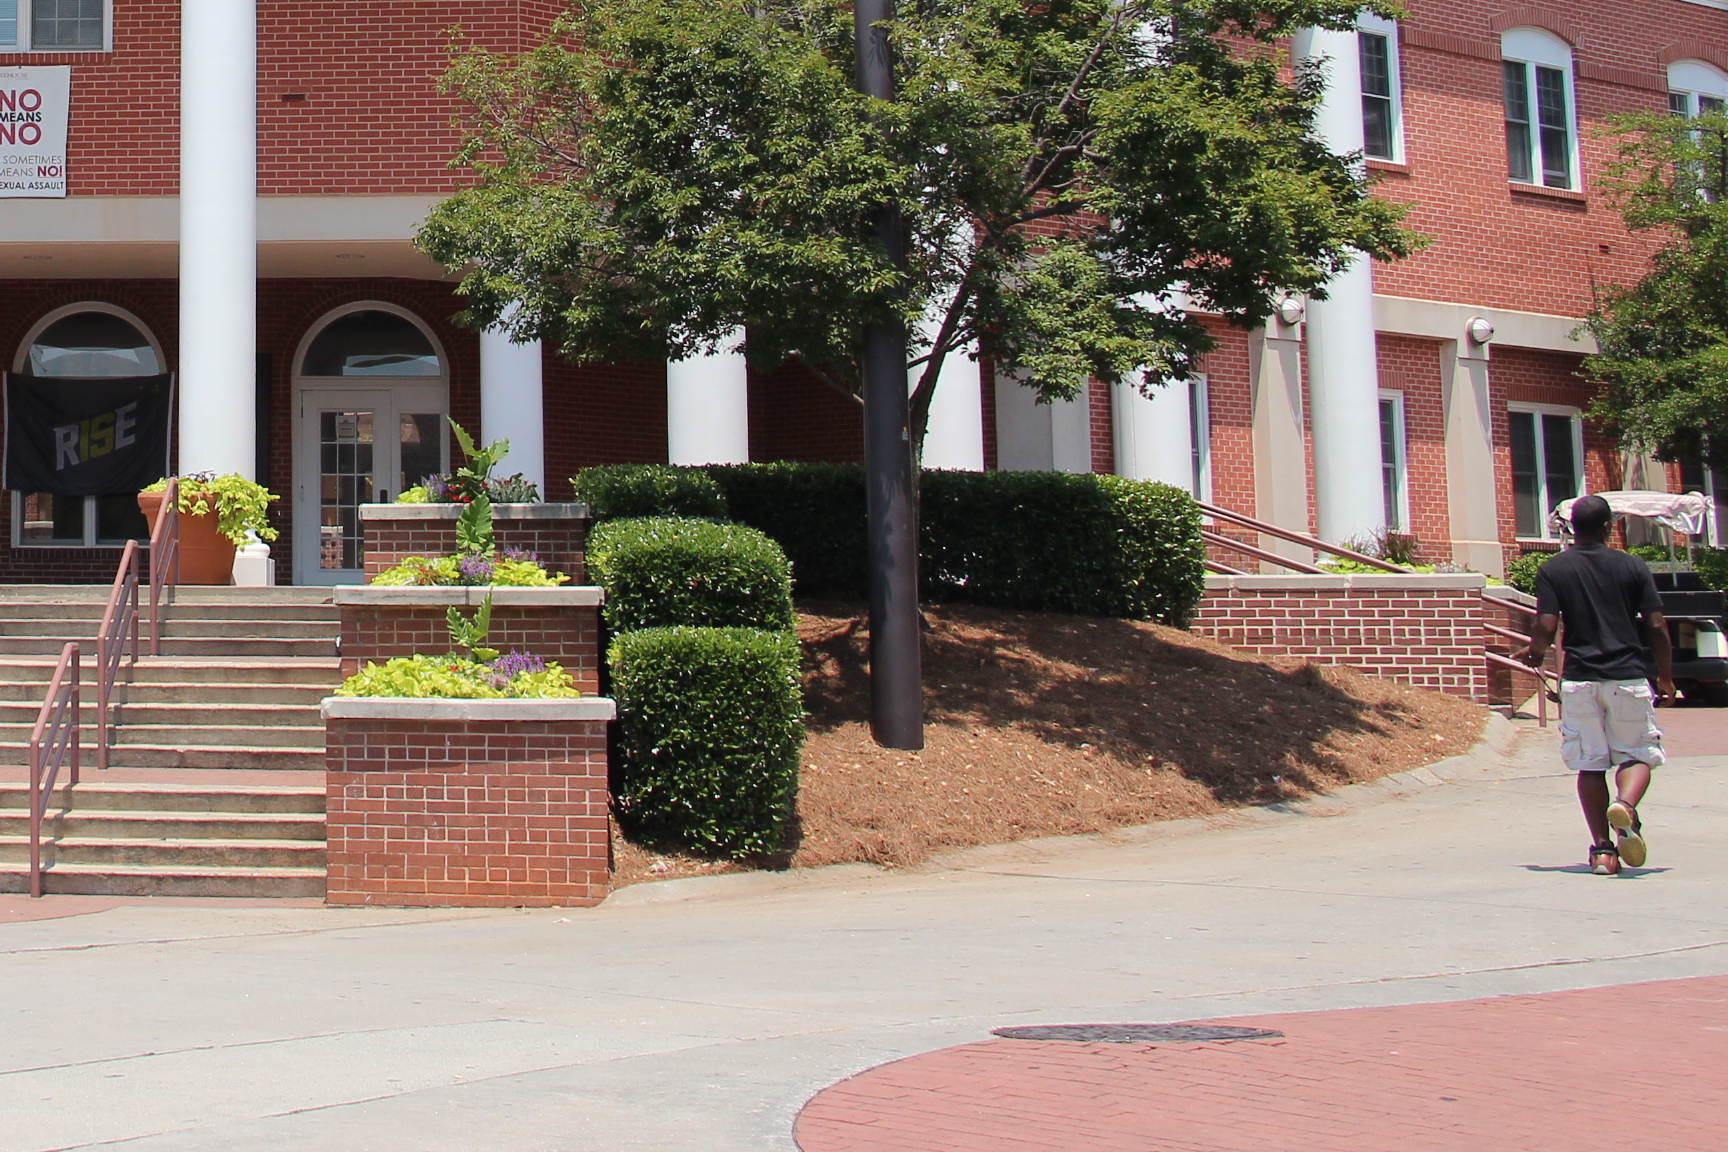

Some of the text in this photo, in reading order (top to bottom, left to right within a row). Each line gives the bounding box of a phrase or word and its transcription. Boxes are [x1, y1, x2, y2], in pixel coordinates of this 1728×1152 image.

[3, 155, 62, 165] SOMETIMES
[37, 165, 63, 178] NO!
[28, 181, 64, 190] ASSAULT
[53, 401, 137, 471] RISE
